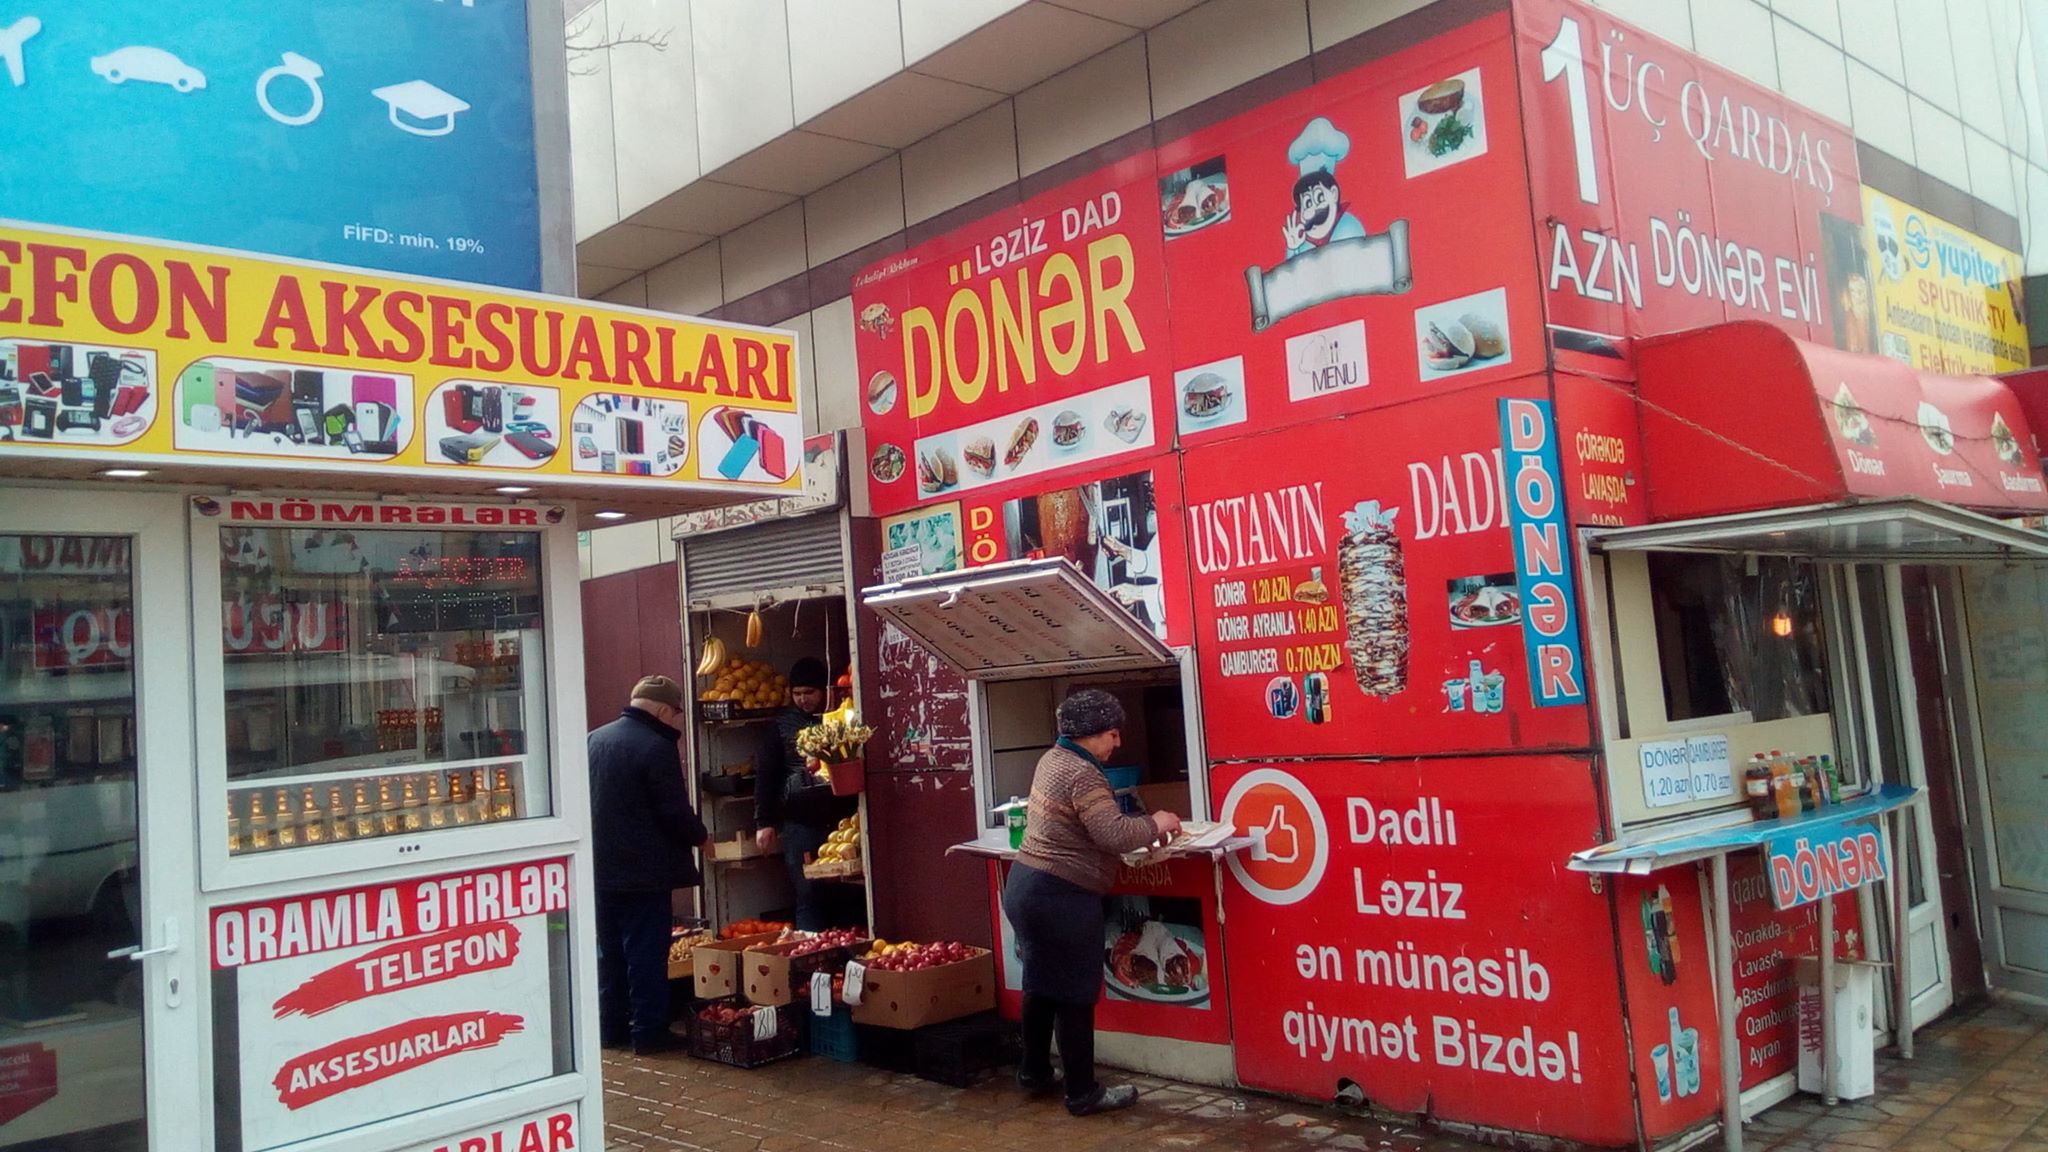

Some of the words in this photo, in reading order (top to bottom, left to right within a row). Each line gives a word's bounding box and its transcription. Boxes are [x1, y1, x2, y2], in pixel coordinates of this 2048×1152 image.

[1541, 16, 1599, 205] 1
[1601, 28, 1667, 143] ÜÇ
[1679, 80, 1834, 207] QARDAŞ
[343, 222, 394, 245] FİFD:
[400, 233, 440, 249] min.
[446, 236, 485, 254] 19%
[974, 217, 1048, 276] LƏZİZ
[1060, 190, 1122, 243] DAD
[1549, 223, 1643, 309] AZN
[1649, 210, 1771, 305] DÖNƏR
[1775, 252, 1822, 326] EVİ
[254, 274, 792, 402] AKSESUARLARI
[901, 233, 1146, 420] DÖNƏR
[1311, 361, 1358, 393] MENU
[230, 498, 539, 525] NÖMRƏLƏR
[1582, 472, 1628, 509] LAVAŞDA
[1189, 482, 1328, 575] USTANIN
[1507, 399, 1581, 699] DÖNƏR
[1214, 577, 1247, 608] DÖNƏR
[1252, 579, 1271, 605] 1.20
[1272, 575, 1292, 602] AZN
[1217, 612, 1250, 642] DÖNƏR
[1253, 610, 1296, 639] AYRANLA
[1297, 608, 1317, 635] 1.40
[1318, 605, 1339, 633] AZN
[1220, 648, 1279, 678] QAMBURGER
[1644, 747, 1687, 769] DÖNƏR
[1650, 776, 1673, 797] 1.20
[1694, 773, 1718, 793] 0.70
[1346, 795, 1458, 847] Dadlı
[1353, 866, 1467, 920] Ləziz
[1771, 833, 1886, 907] DÖNƏR
[215, 887, 403, 969] QRAMLA
[417, 862, 568, 932] ƏTİRLƏR
[356, 928, 507, 993] TELEFON
[1296, 943, 1342, 982] ən
[1356, 941, 1551, 1002] münasib
[288, 1017, 486, 1093] AKSESUARLARI
[1283, 1001, 1421, 1063] qiymət
[1432, 1014, 1583, 1085] Bizdə!
[1750, 1039, 1781, 1068] Ayran
